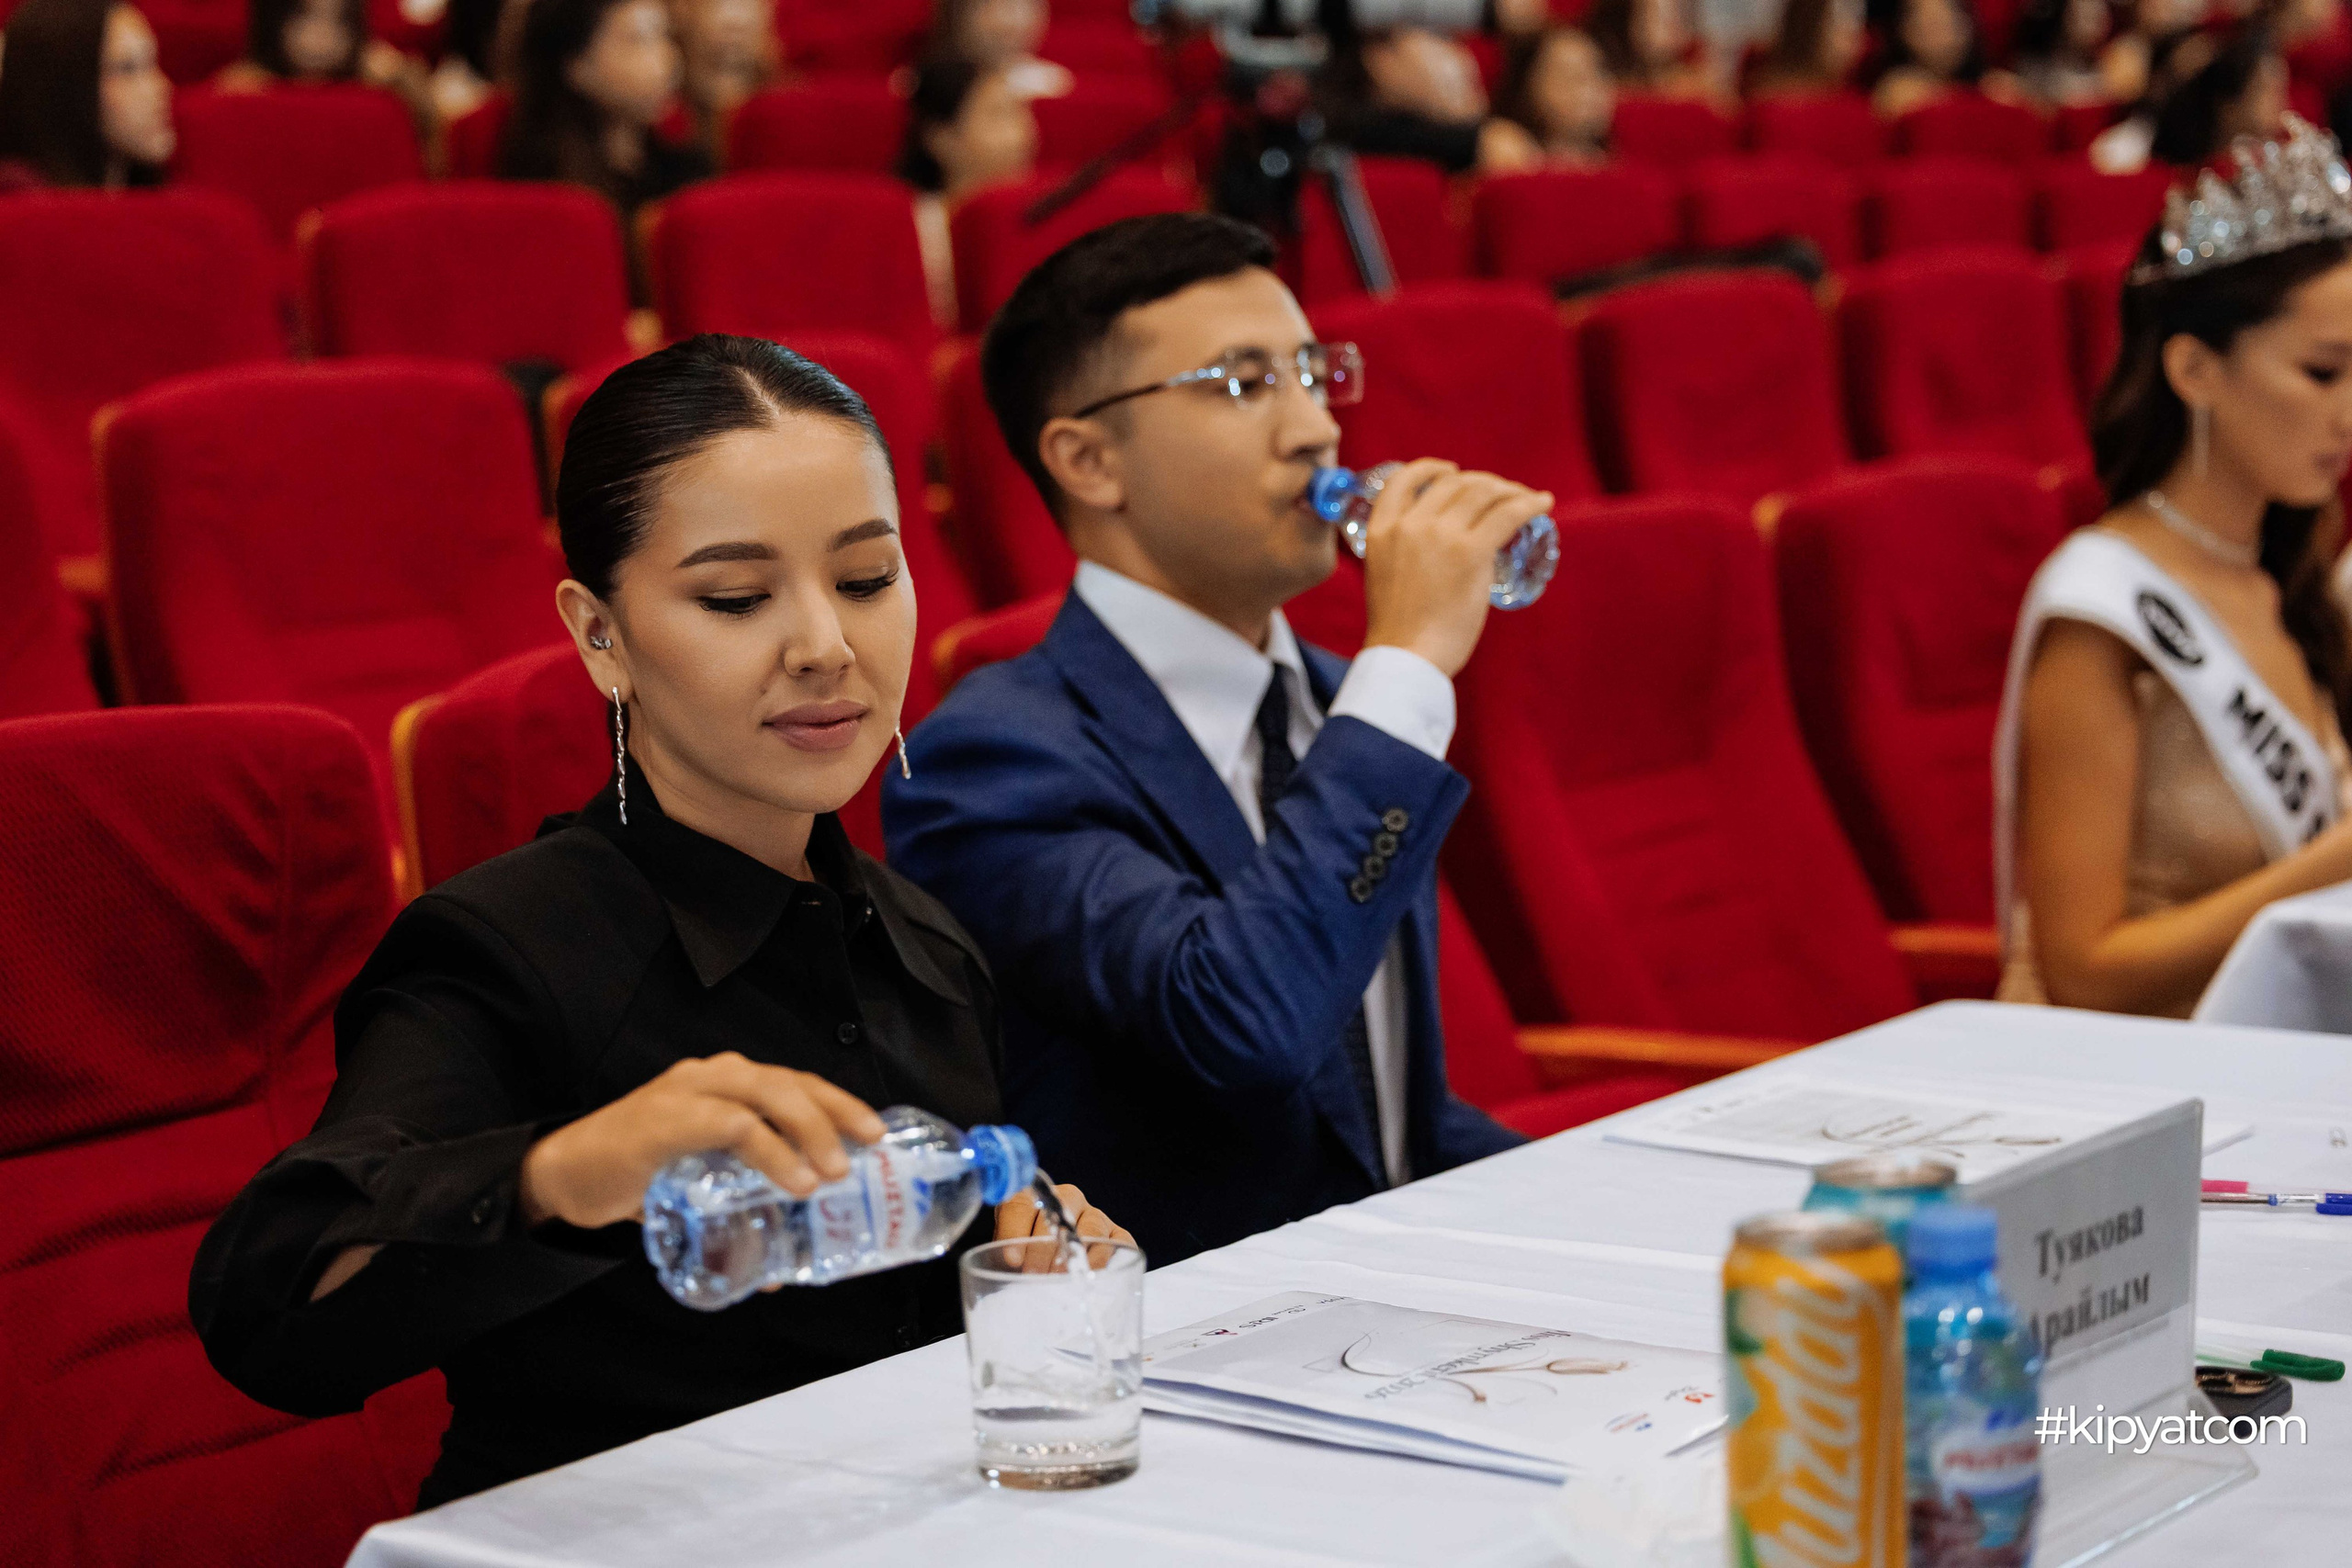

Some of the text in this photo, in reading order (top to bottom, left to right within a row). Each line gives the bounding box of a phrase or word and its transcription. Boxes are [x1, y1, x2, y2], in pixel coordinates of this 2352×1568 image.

[2223, 687, 2313, 814] MISS
[2034, 1205, 2144, 1285] Туякова
[1753, 1254, 1883, 1568] uzday
